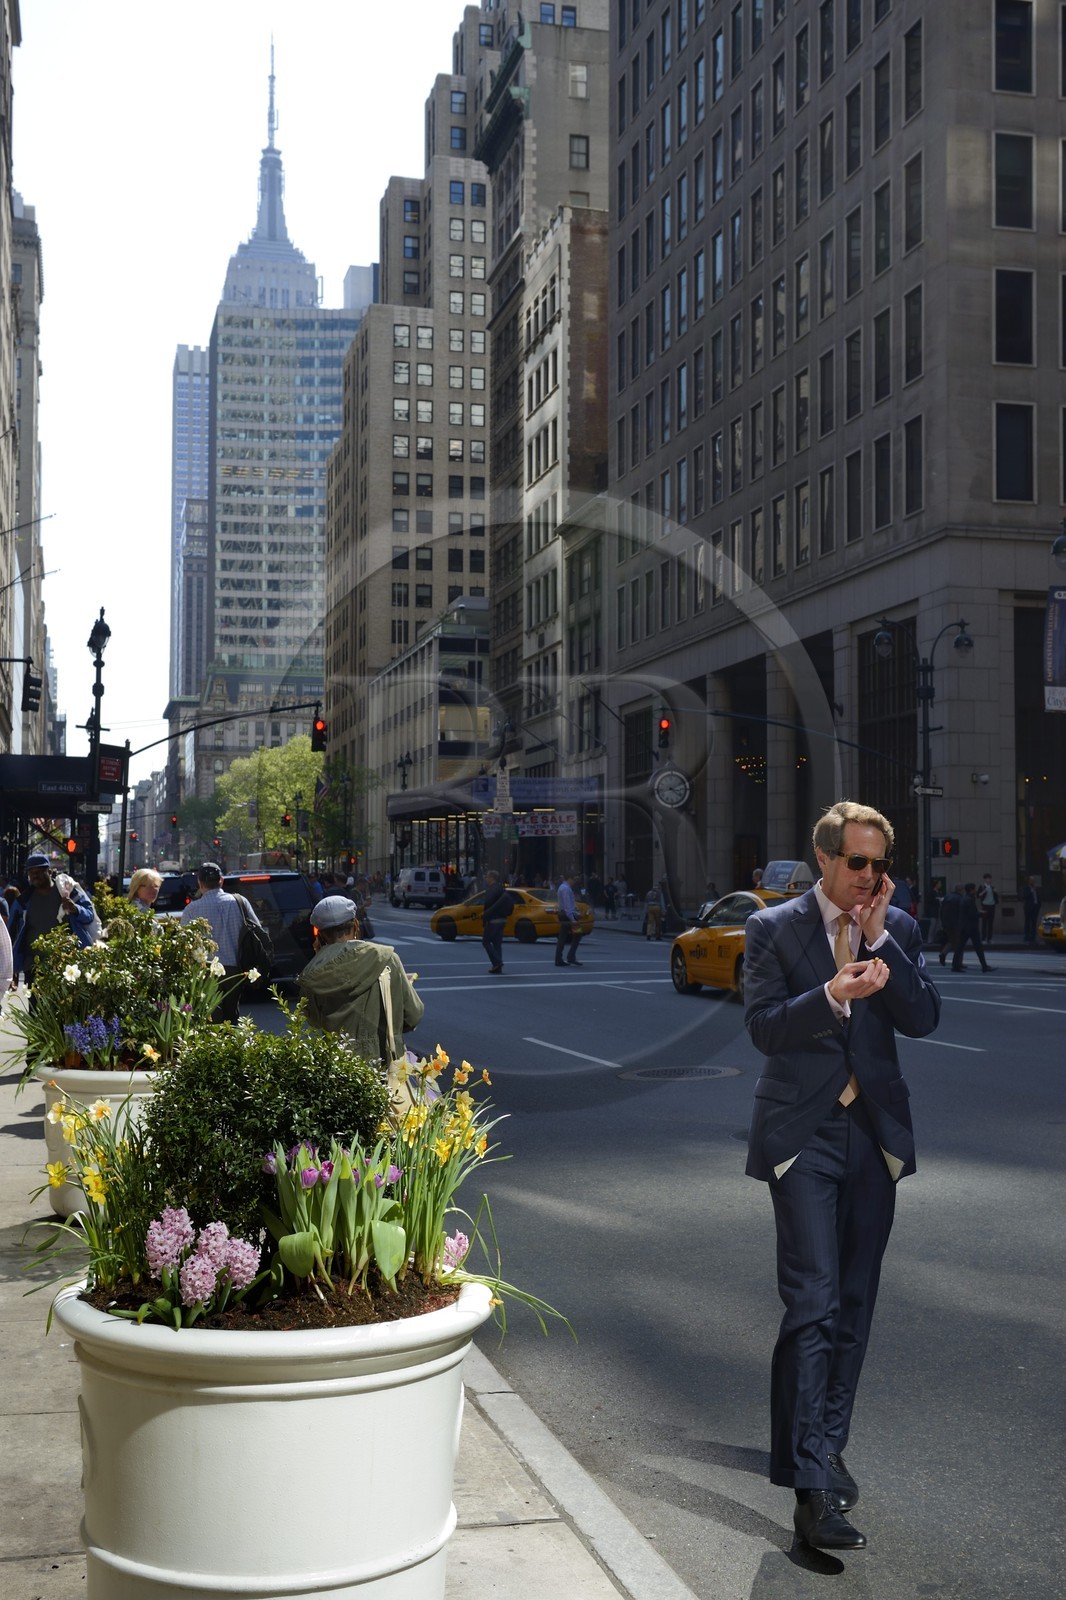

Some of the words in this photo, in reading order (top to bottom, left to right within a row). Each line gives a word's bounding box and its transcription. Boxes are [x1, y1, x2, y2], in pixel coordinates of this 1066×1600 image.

[42, 784, 57, 792] East
[58, 785, 74, 793] 44th
[75, 785, 83, 793] St
[541, 815, 575, 824] SALE
